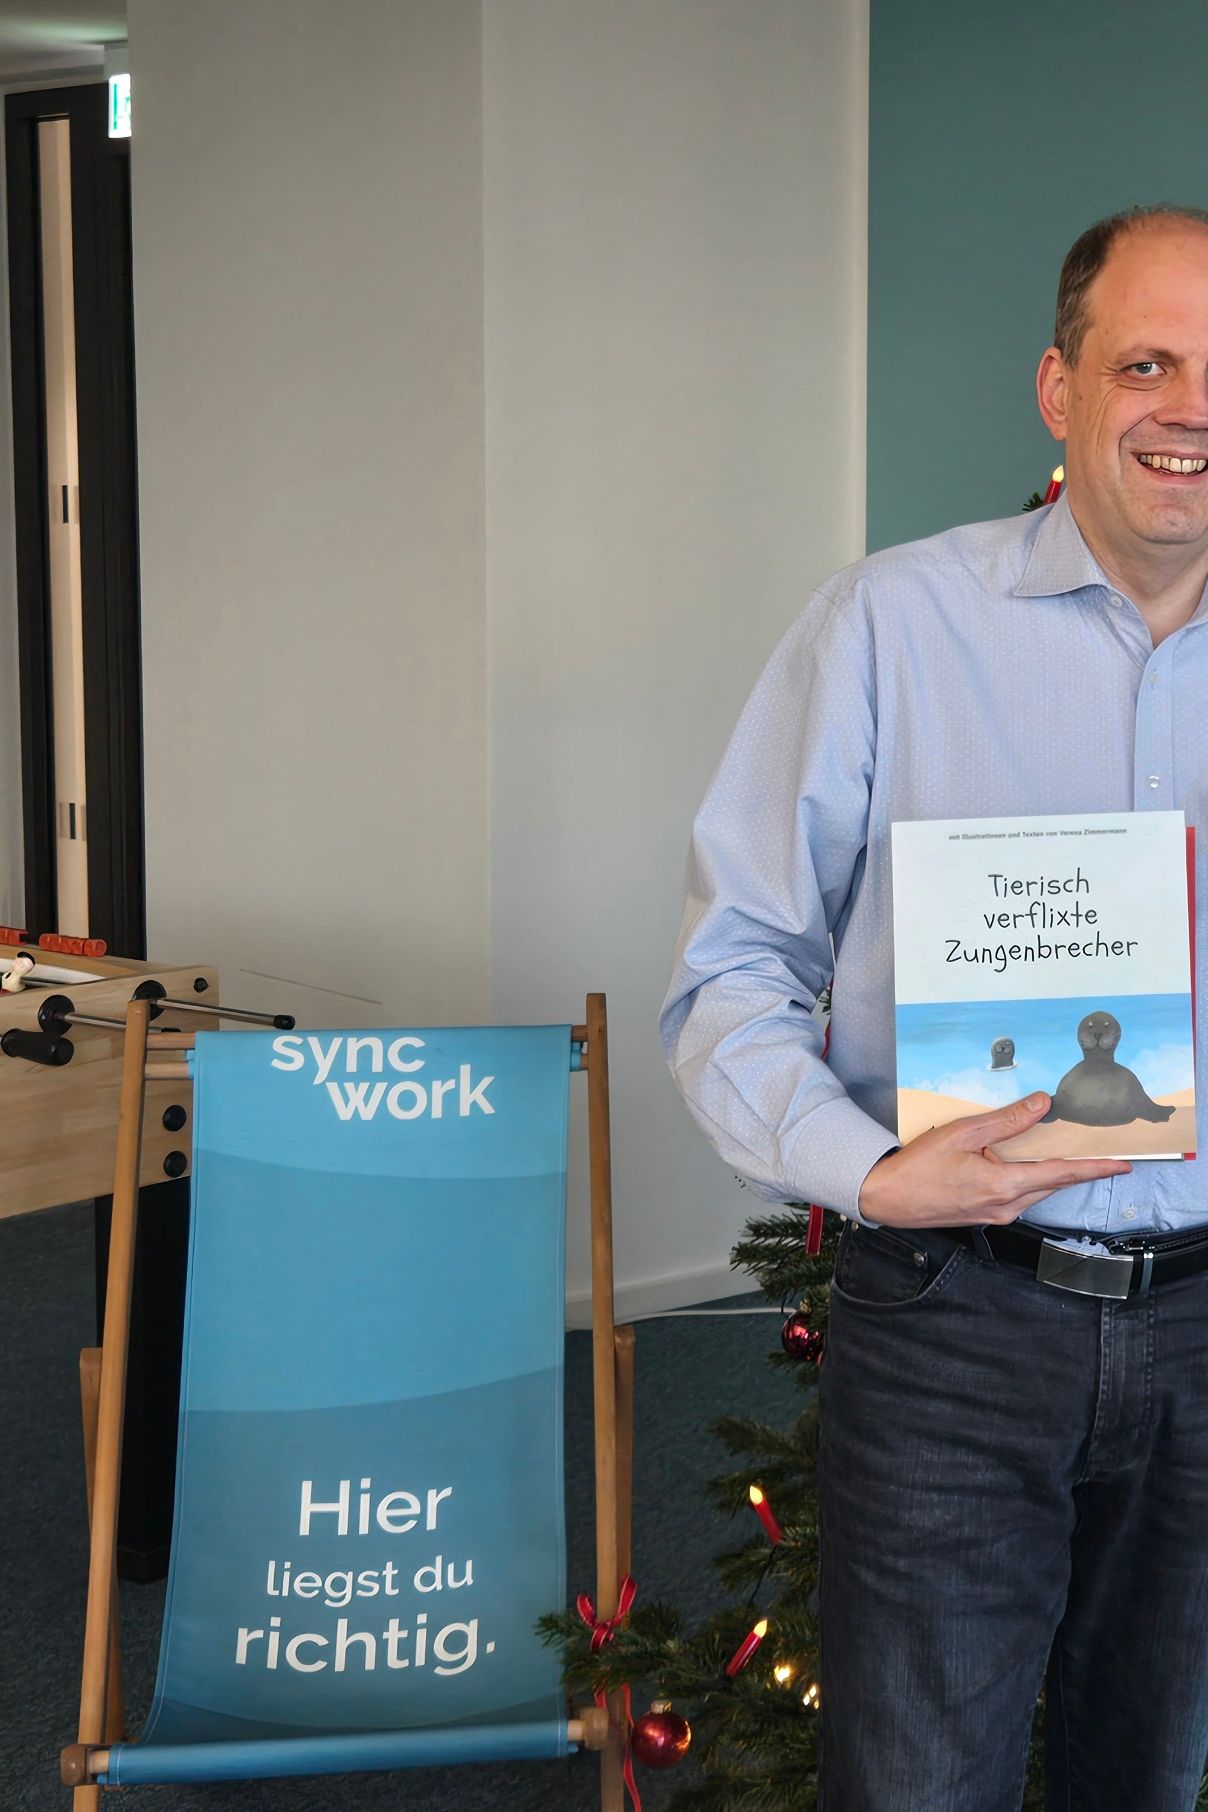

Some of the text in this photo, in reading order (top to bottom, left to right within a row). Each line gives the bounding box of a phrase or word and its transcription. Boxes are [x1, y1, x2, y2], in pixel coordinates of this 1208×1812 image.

[1008, 831, 1020, 839] und
[1059, 829, 1082, 837] Verena
[987, 867, 1090, 898] Tierisch
[983, 901, 1099, 930] verflixte
[944, 931, 1139, 973] Zungenbrecher
[270, 1035, 426, 1085] sync
[325, 1064, 496, 1120] work
[299, 1477, 453, 1536] Hier
[266, 1555, 474, 1608] liegst du
[235, 1612, 495, 1676] richtig.
